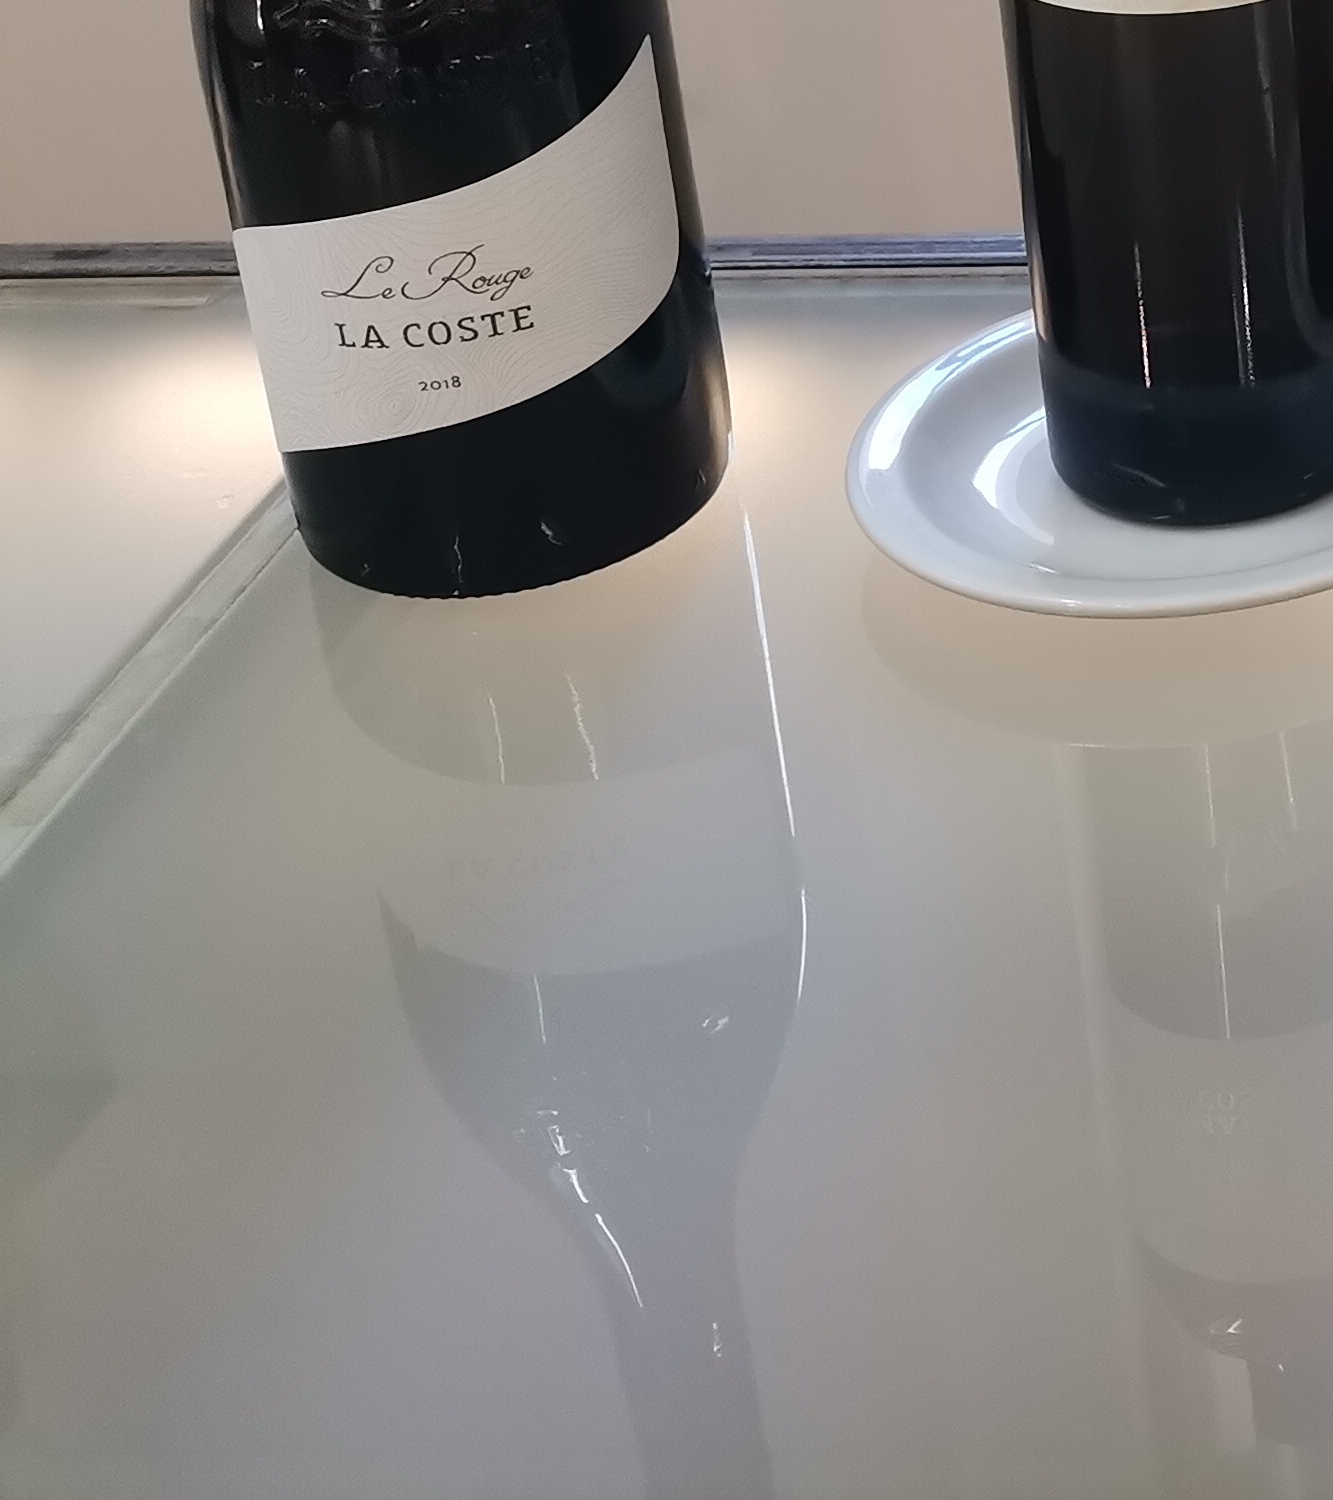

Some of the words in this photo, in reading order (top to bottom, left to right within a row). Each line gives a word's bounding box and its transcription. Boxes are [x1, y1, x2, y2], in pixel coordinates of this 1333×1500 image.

[320, 255, 397, 300] Le
[400, 243, 535, 302] Rouge
[333, 321, 390, 349] LA
[402, 304, 535, 348] COSTE
[417, 374, 463, 393] 2018
